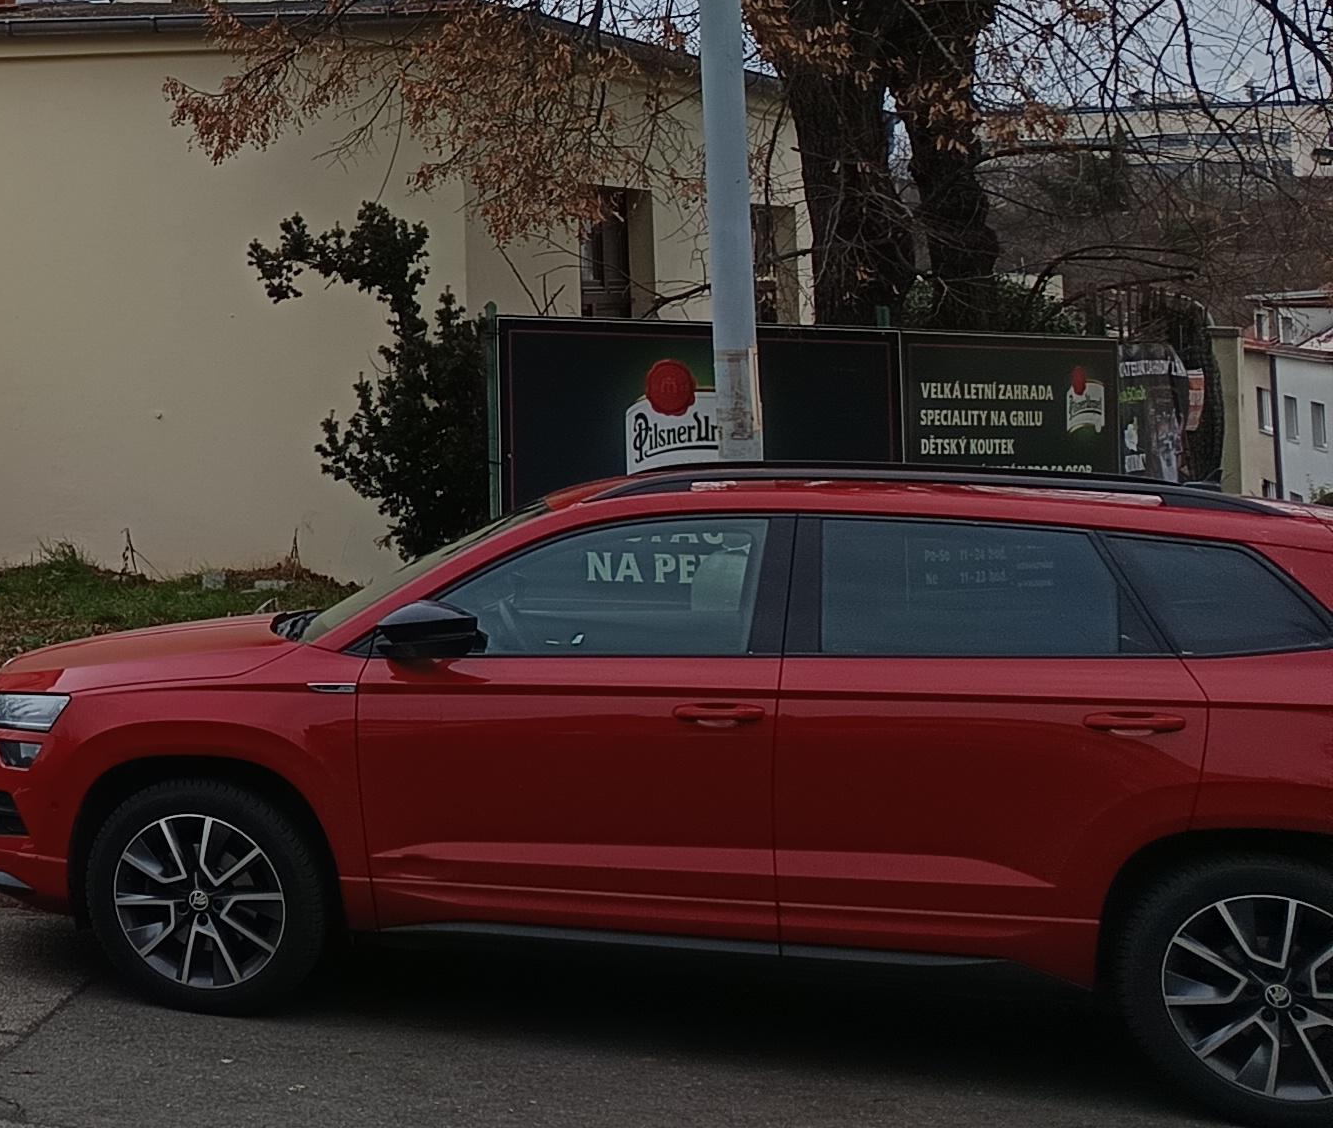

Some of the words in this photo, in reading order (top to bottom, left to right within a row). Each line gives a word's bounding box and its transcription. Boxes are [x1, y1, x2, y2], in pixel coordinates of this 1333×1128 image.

[920, 380, 960, 399] VELKÁ
[964, 381, 997, 400] LETNÍ
[998, 384, 1054, 400] ZAHRADA
[920, 409, 988, 426] SPECIALITY
[990, 410, 1008, 426] NA
[1009, 410, 1043, 426] GRILU
[921, 435, 966, 455] DĚTSKÝ
[969, 438, 1015, 455] KOUTEK
[586, 551, 644, 583] NA
[653, 553, 709, 584] PE
